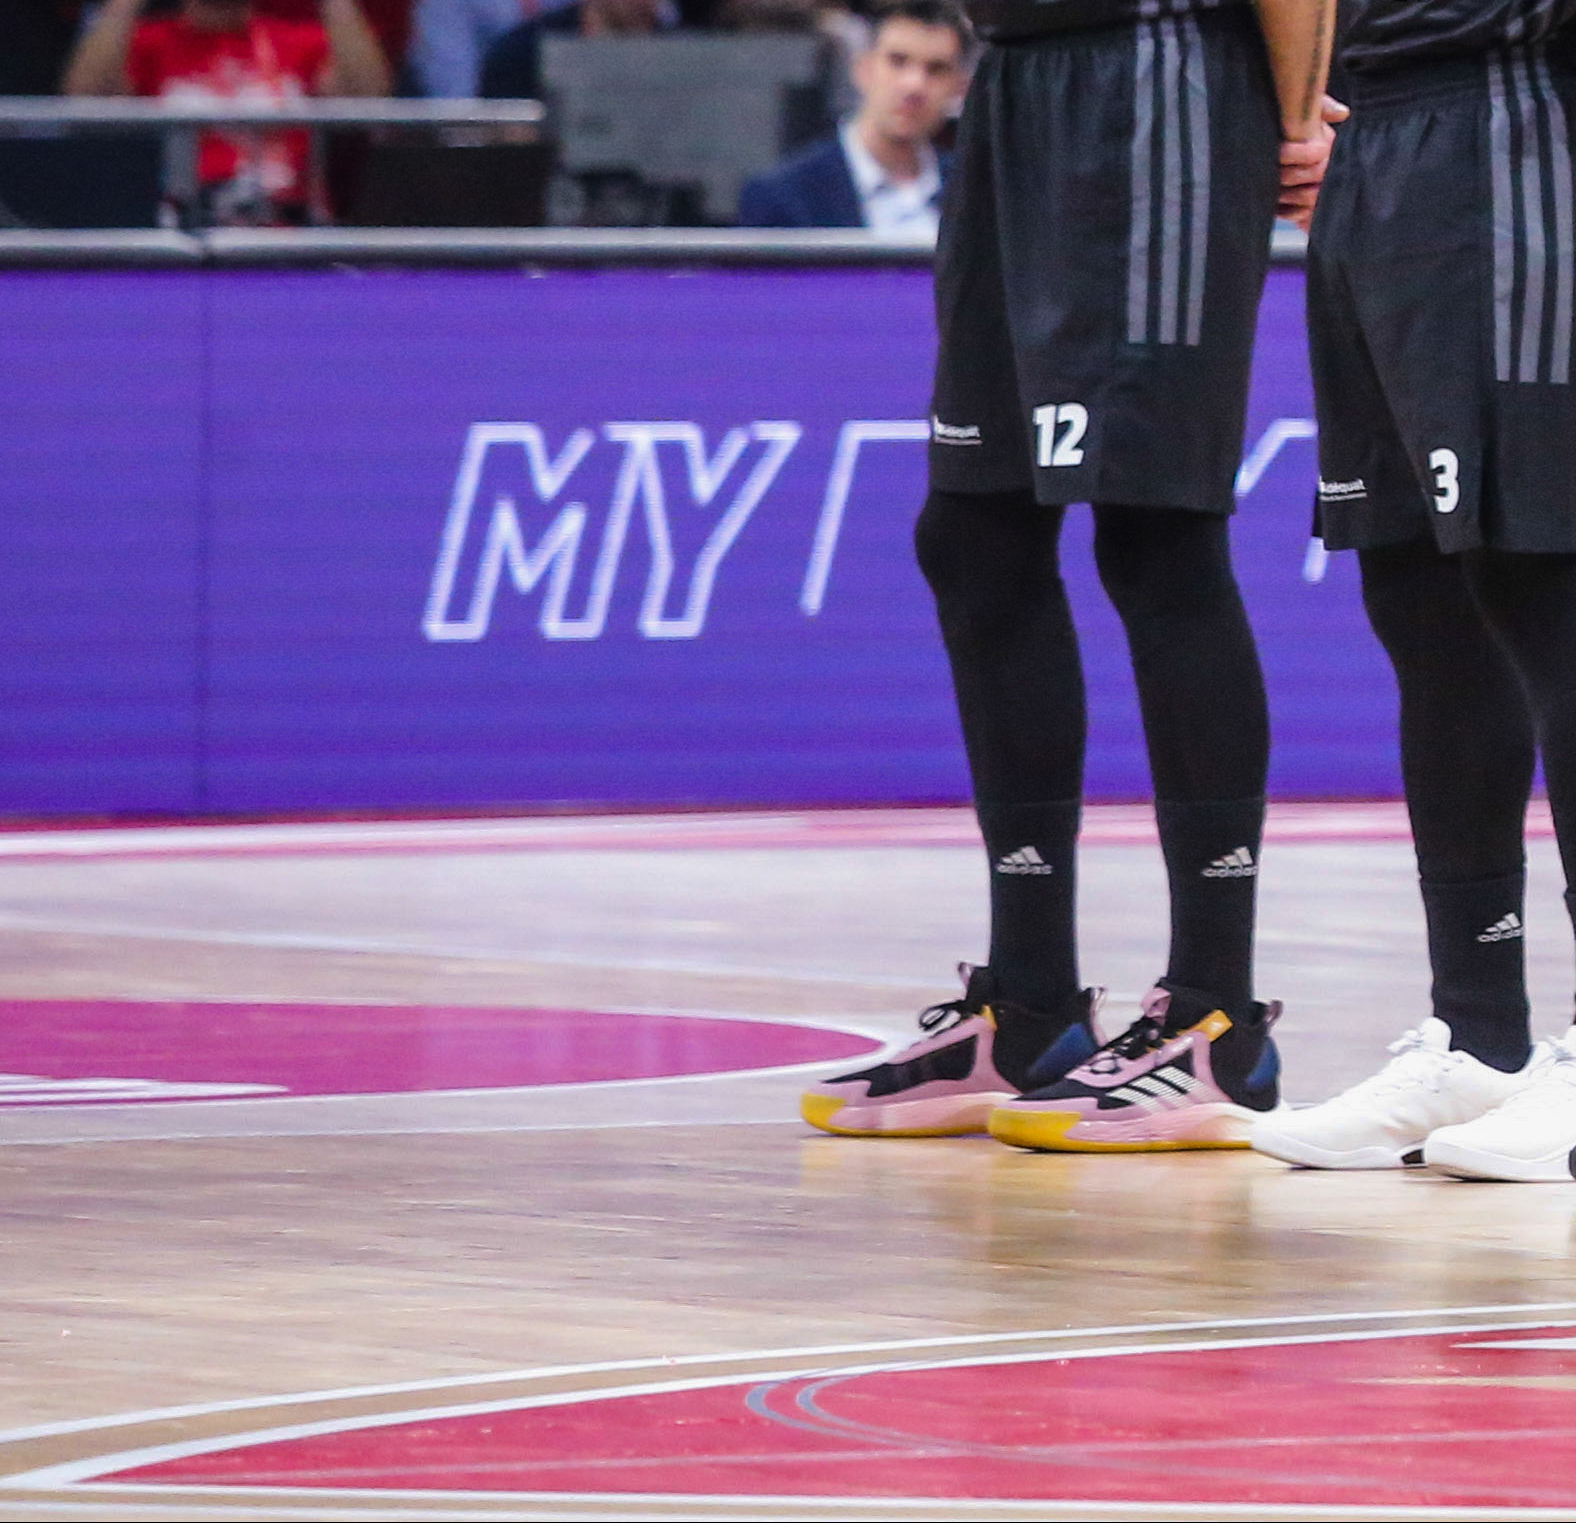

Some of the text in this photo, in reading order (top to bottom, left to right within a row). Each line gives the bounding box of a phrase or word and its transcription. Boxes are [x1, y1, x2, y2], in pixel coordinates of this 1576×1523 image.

[1033, 401, 1089, 467] 12
[1428, 448, 1460, 514] 3
[423, 420, 801, 643] MY
